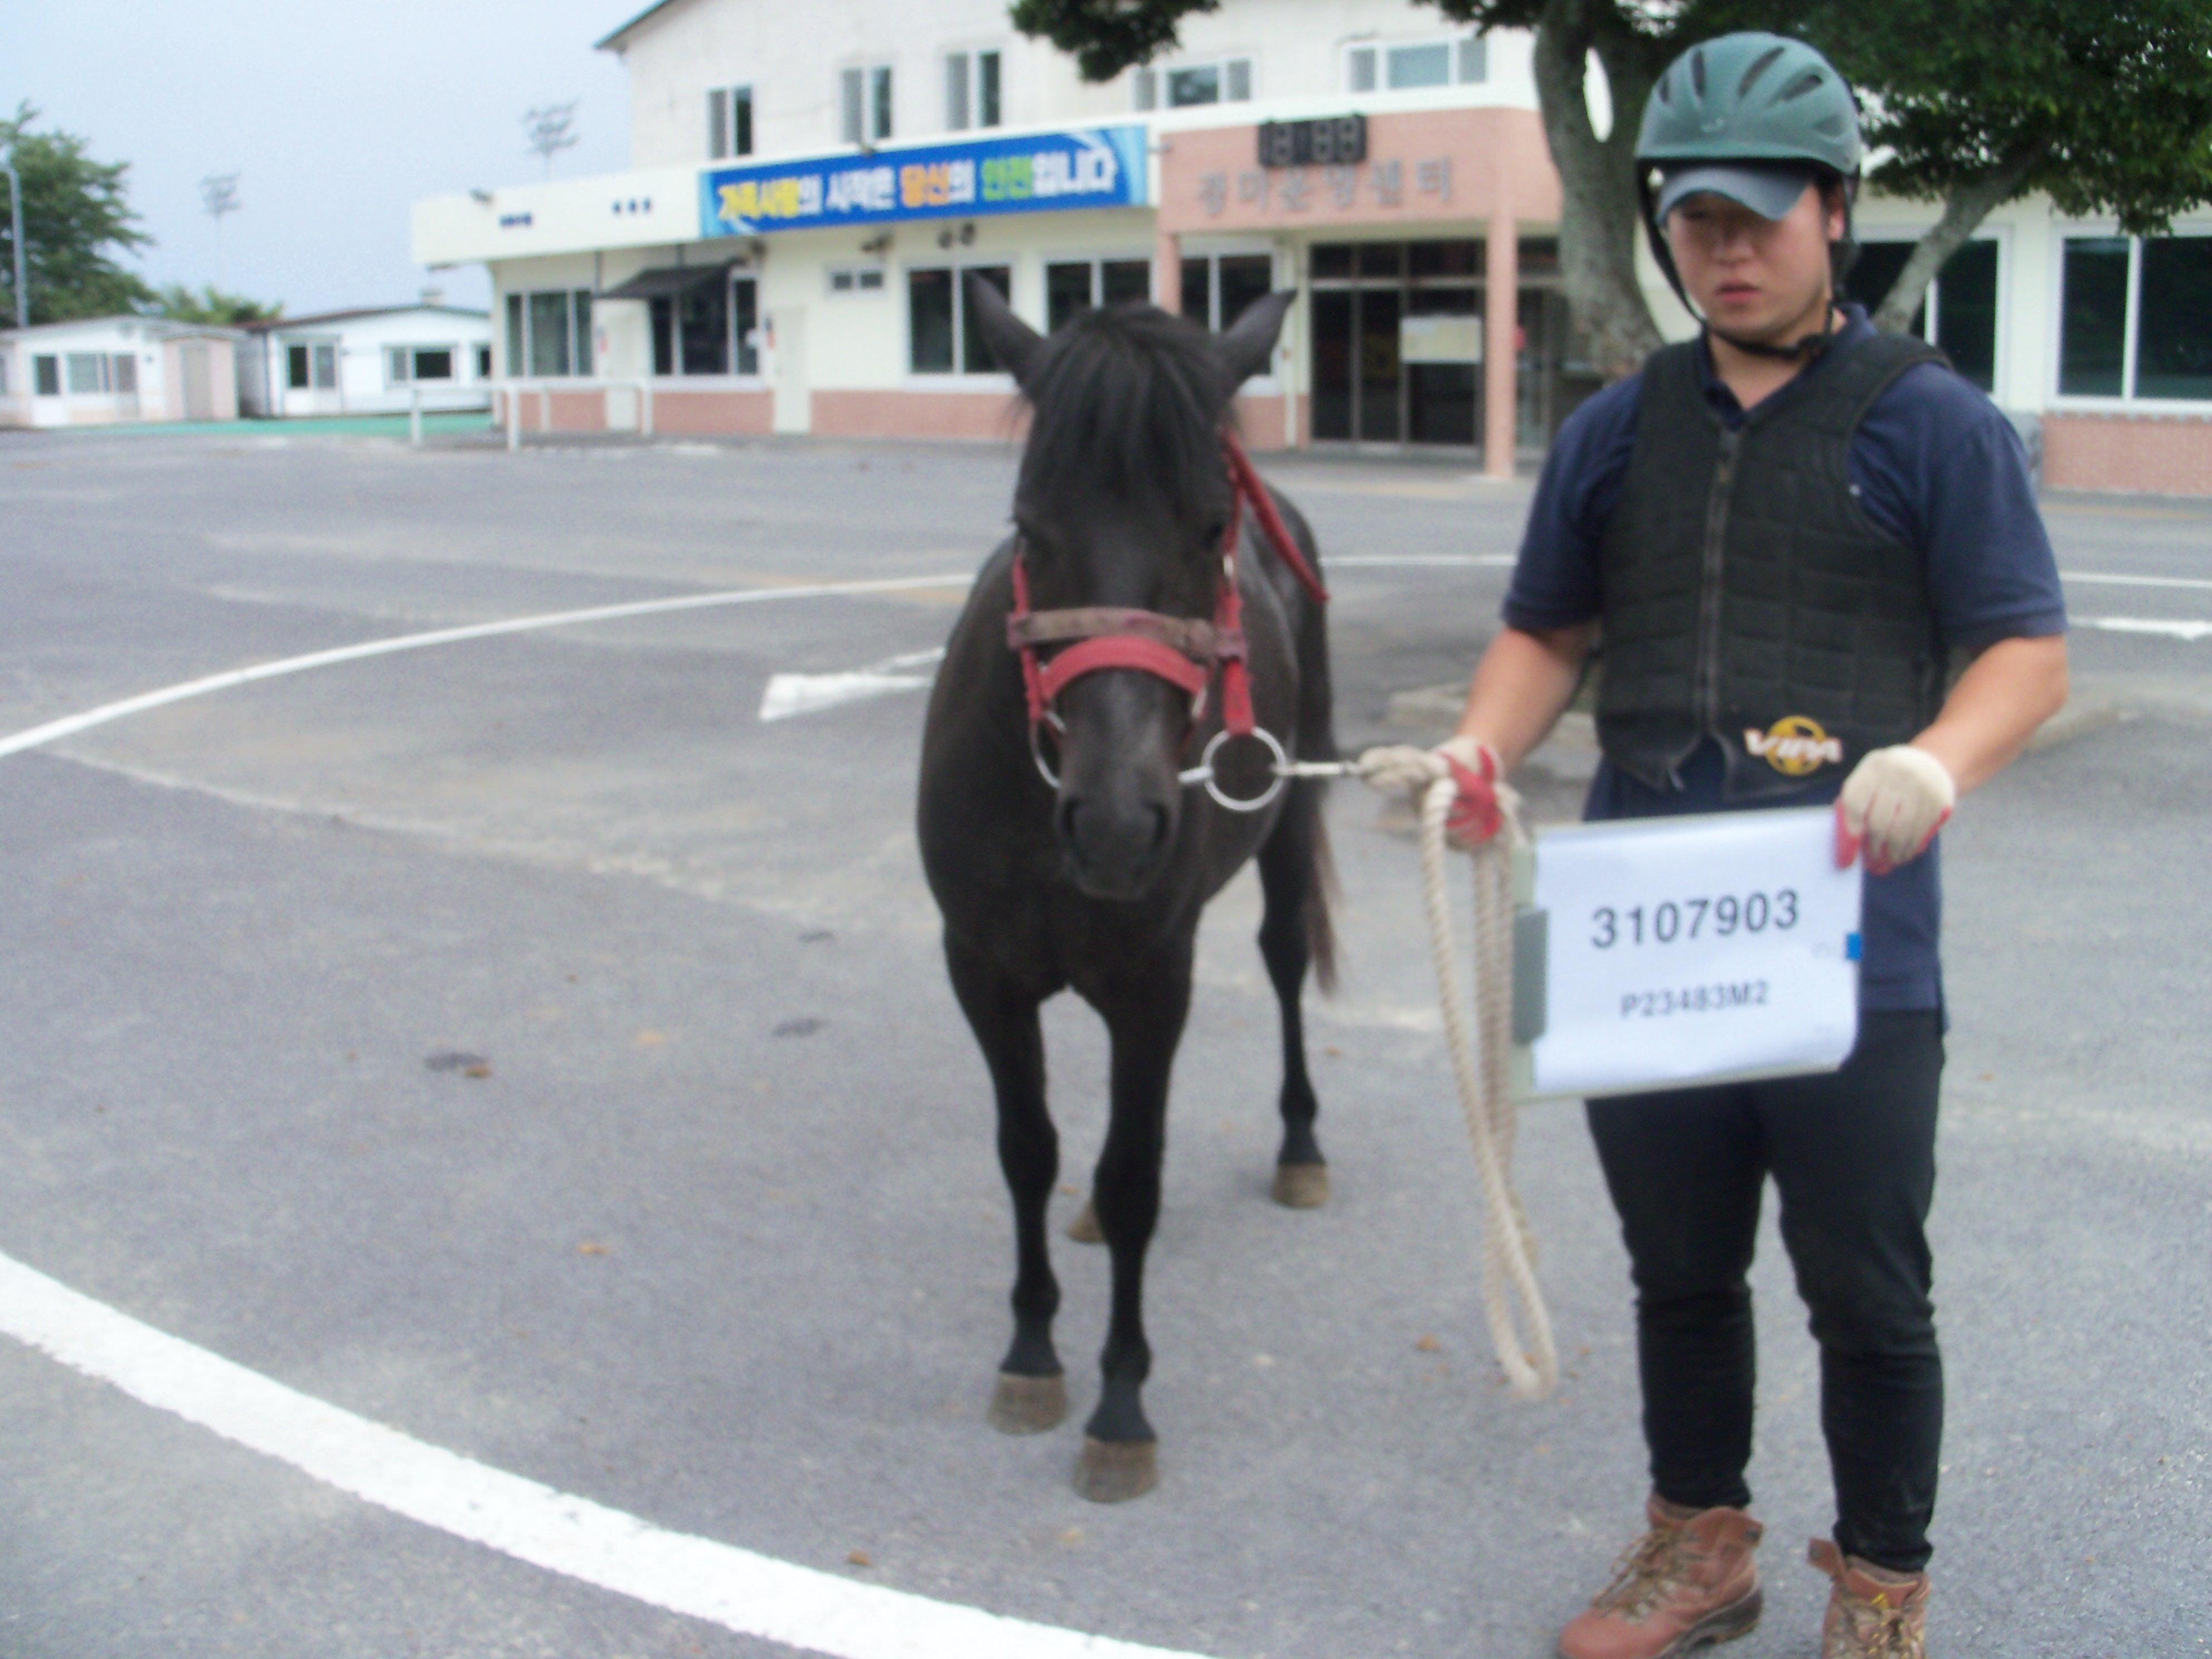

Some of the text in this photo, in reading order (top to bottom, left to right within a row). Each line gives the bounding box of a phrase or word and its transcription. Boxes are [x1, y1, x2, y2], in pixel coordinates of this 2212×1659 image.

[826, 168, 894, 211] 시작은
[900, 160, 974, 207] 당신의
[1592, 890, 1799, 949] 3107903
[1621, 979, 1768, 1018] P23483M2
